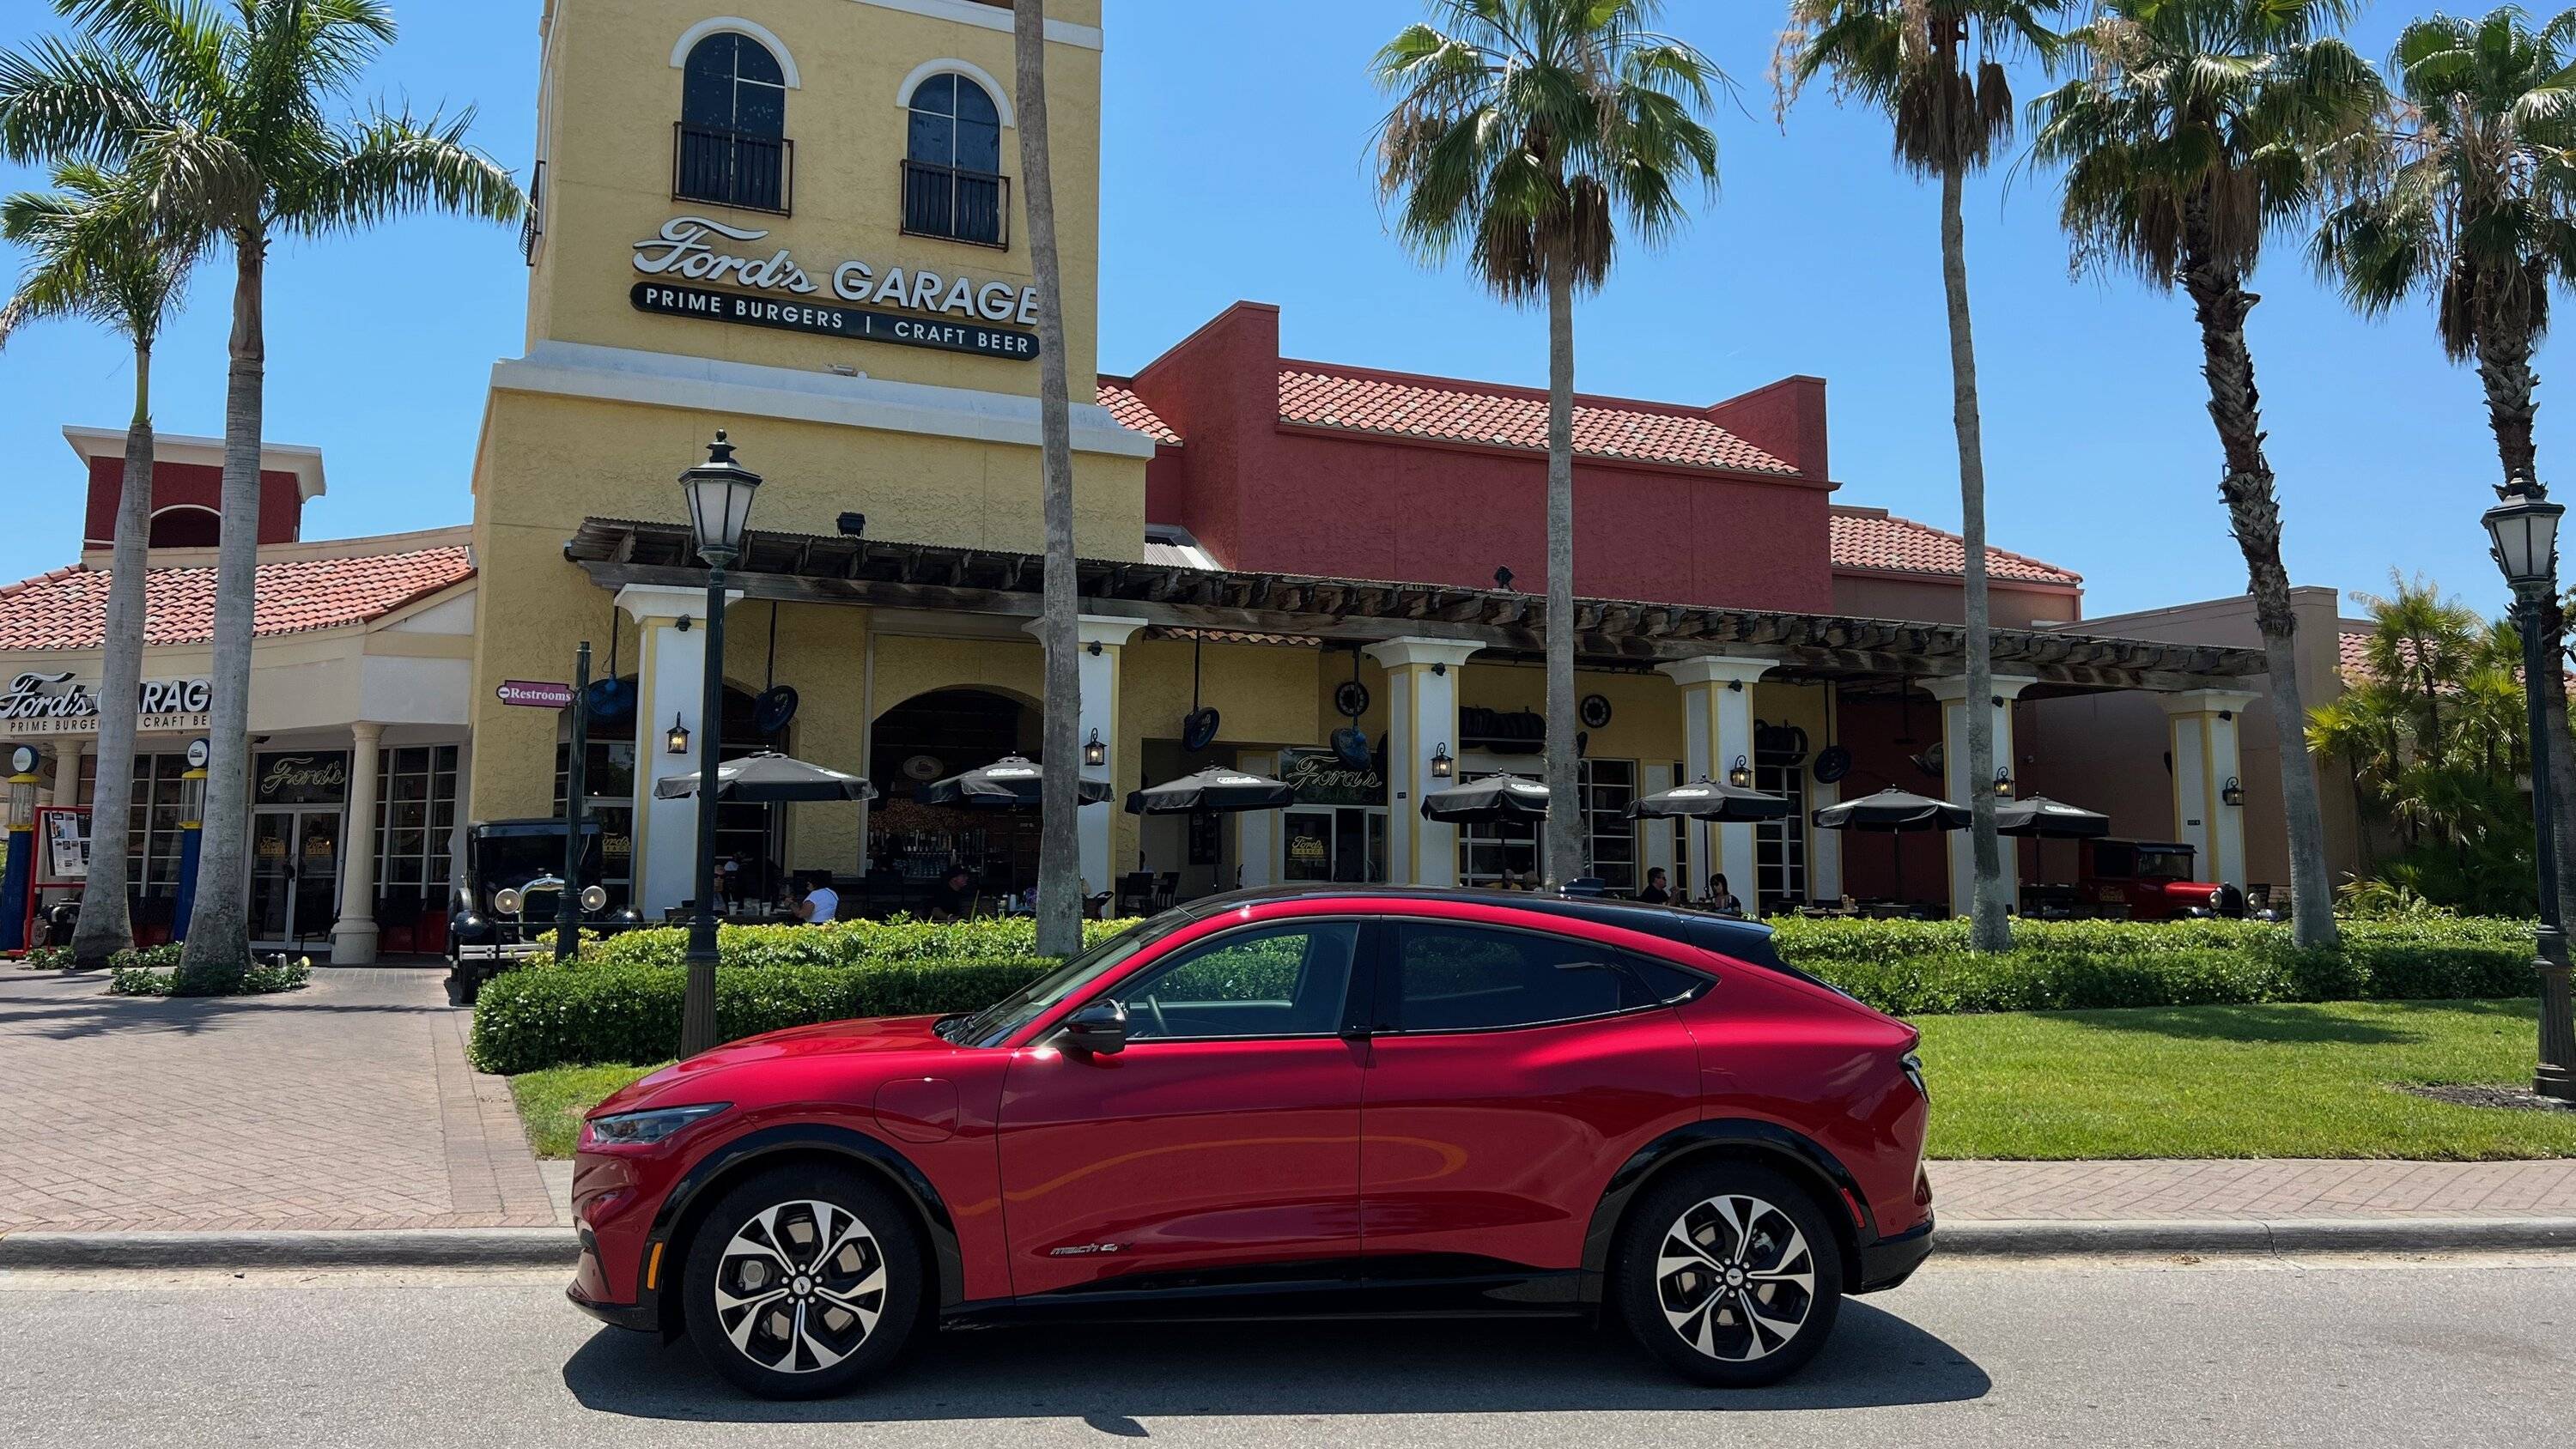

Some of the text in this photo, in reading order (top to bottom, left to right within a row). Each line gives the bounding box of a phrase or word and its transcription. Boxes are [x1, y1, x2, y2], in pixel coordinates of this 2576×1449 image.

[633, 216, 1038, 324] Ford's GARAGE
[646, 288, 721, 312] PRIME
[736, 300, 842, 328] BURGERS
[895, 321, 965, 344] CRAFT
[977, 332, 1029, 353] BEER
[0, 671, 212, 719] Ford's RAG
[510, 688, 571, 701] Restrooms
[9, 715, 212, 732] PRIME BURGE CRAFT BE
[261, 757, 345, 794] Ford's
